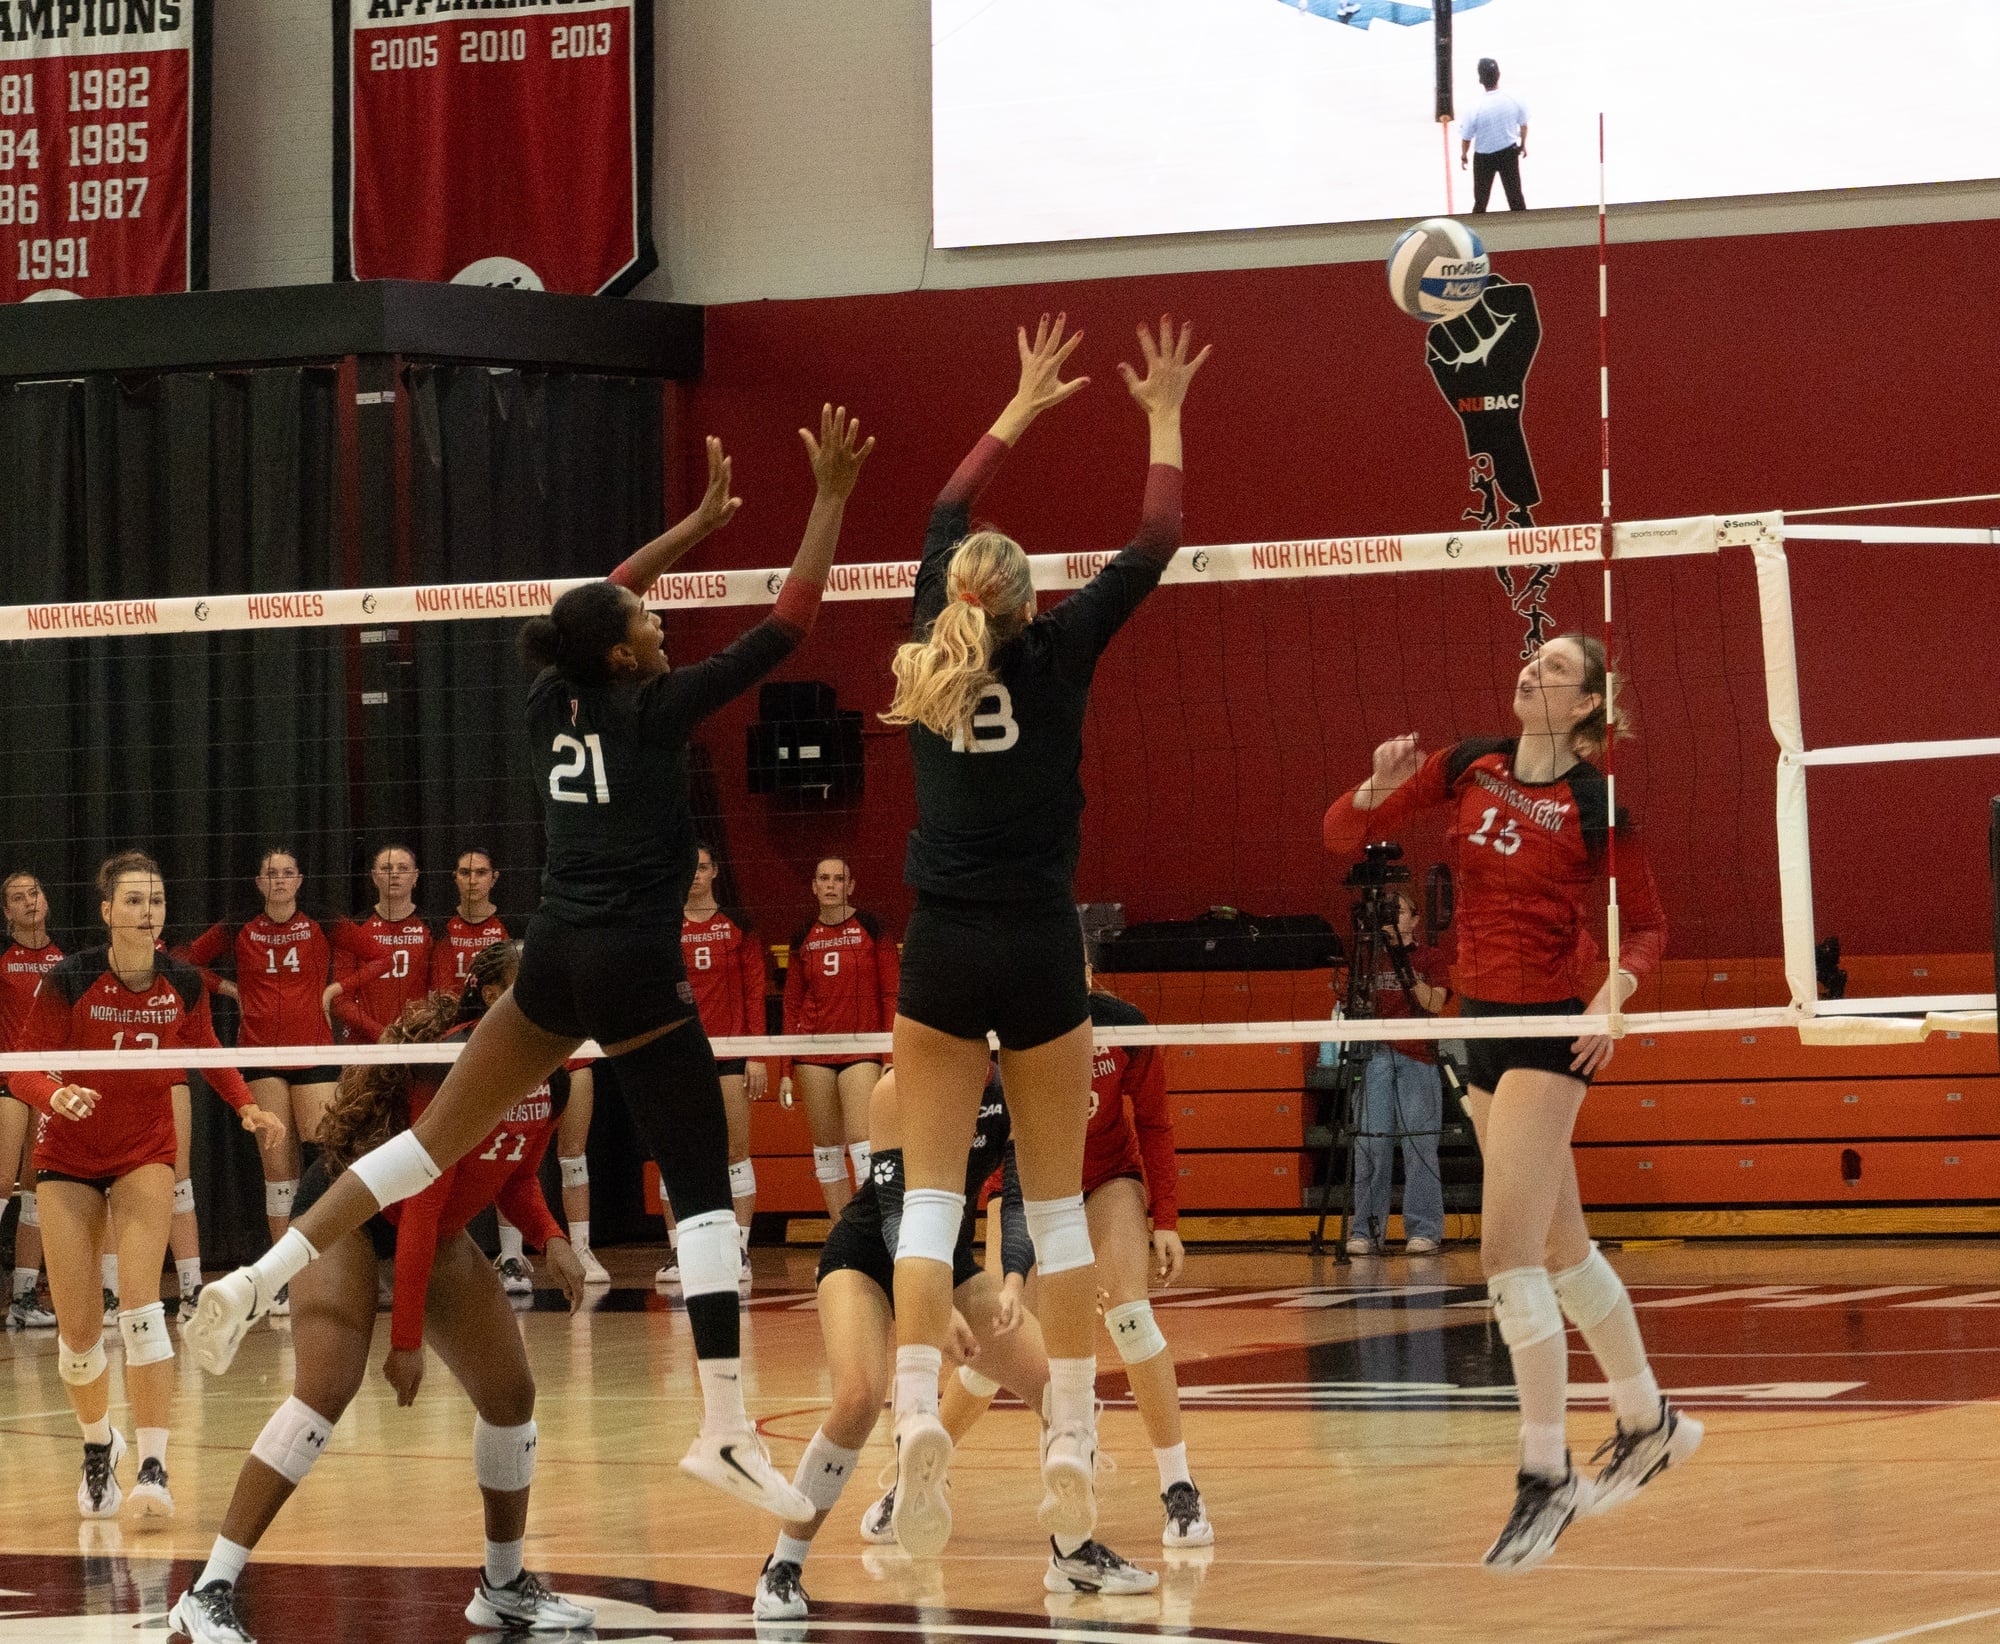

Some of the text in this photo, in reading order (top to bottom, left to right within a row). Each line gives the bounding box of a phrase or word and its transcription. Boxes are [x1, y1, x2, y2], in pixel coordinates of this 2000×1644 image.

[371, 22, 611, 71] 2005 2010 2013
[68, 66, 150, 112] 1982
[69, 122, 149, 167] 1985
[68, 177, 149, 222] 1987
[17, 237, 89, 281] 1991
[1441, 261, 1486, 276] molten
[1458, 394, 1520, 412] NUBAC
[27, 602, 158, 631] NORTHEASTERN
[248, 594, 325, 620] HUSKIES
[415, 581, 553, 611] NORTHEASTERN
[648, 574, 727, 600] HUSKIES
[1252, 538, 1402, 570] NORTHEASTERN
[1507, 525, 1597, 556] HUSKIES
[549, 733, 610, 803] 21
[250, 931, 311, 945] NORTHEASTERN
[266, 947, 300, 973] 14
[823, 951, 840, 976] 9
[90, 1005, 178, 1024] NORTHEASTERN
[147, 994, 176, 1006] CAA
[479, 1132, 527, 1161] 11
